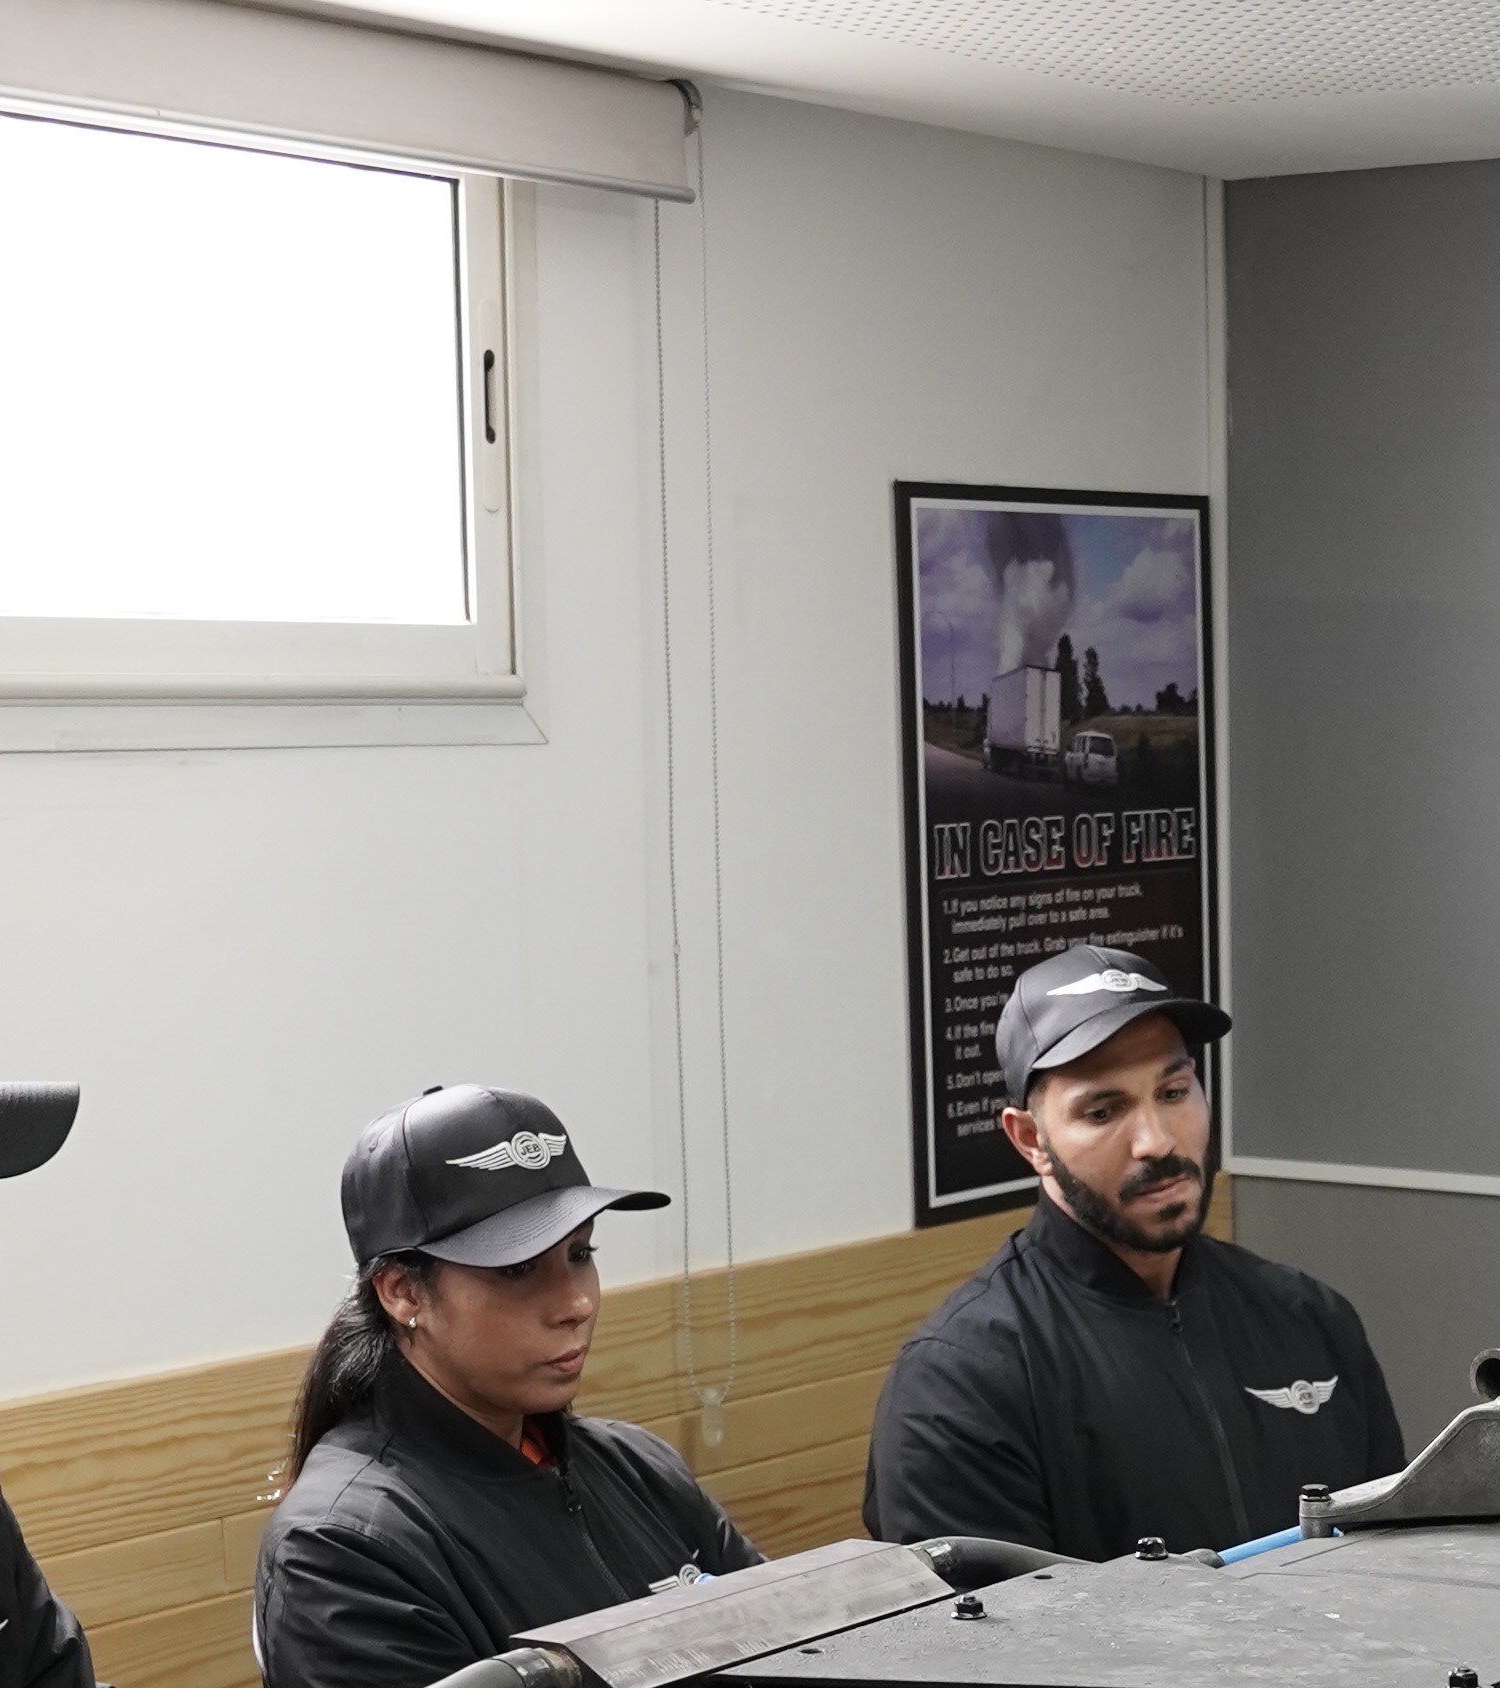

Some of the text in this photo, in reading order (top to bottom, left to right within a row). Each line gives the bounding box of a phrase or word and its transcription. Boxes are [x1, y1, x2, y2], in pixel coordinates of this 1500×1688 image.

[934, 807, 1197, 880] IN CASE OF FIRE
[960, 900, 979, 917] you
[980, 895, 1008, 911] notice
[1010, 895, 1027, 911] any
[1027, 892, 1053, 909] signs
[1054, 888, 1065, 903] of
[1065, 888, 1081, 902] fire
[1081, 889, 1095, 901] on
[1095, 887, 1117, 903] your
[971, 945, 988, 961] out
[988, 943, 999, 959] of
[999, 942, 1016, 958] the
[1042, 936, 1067, 952] Grab
[953, 967, 974, 983] safe
[974, 966, 986, 980] to
[986, 964, 1000, 979] do
[962, 1023, 979, 1039] the
[520, 1143, 541, 1156] JEB
